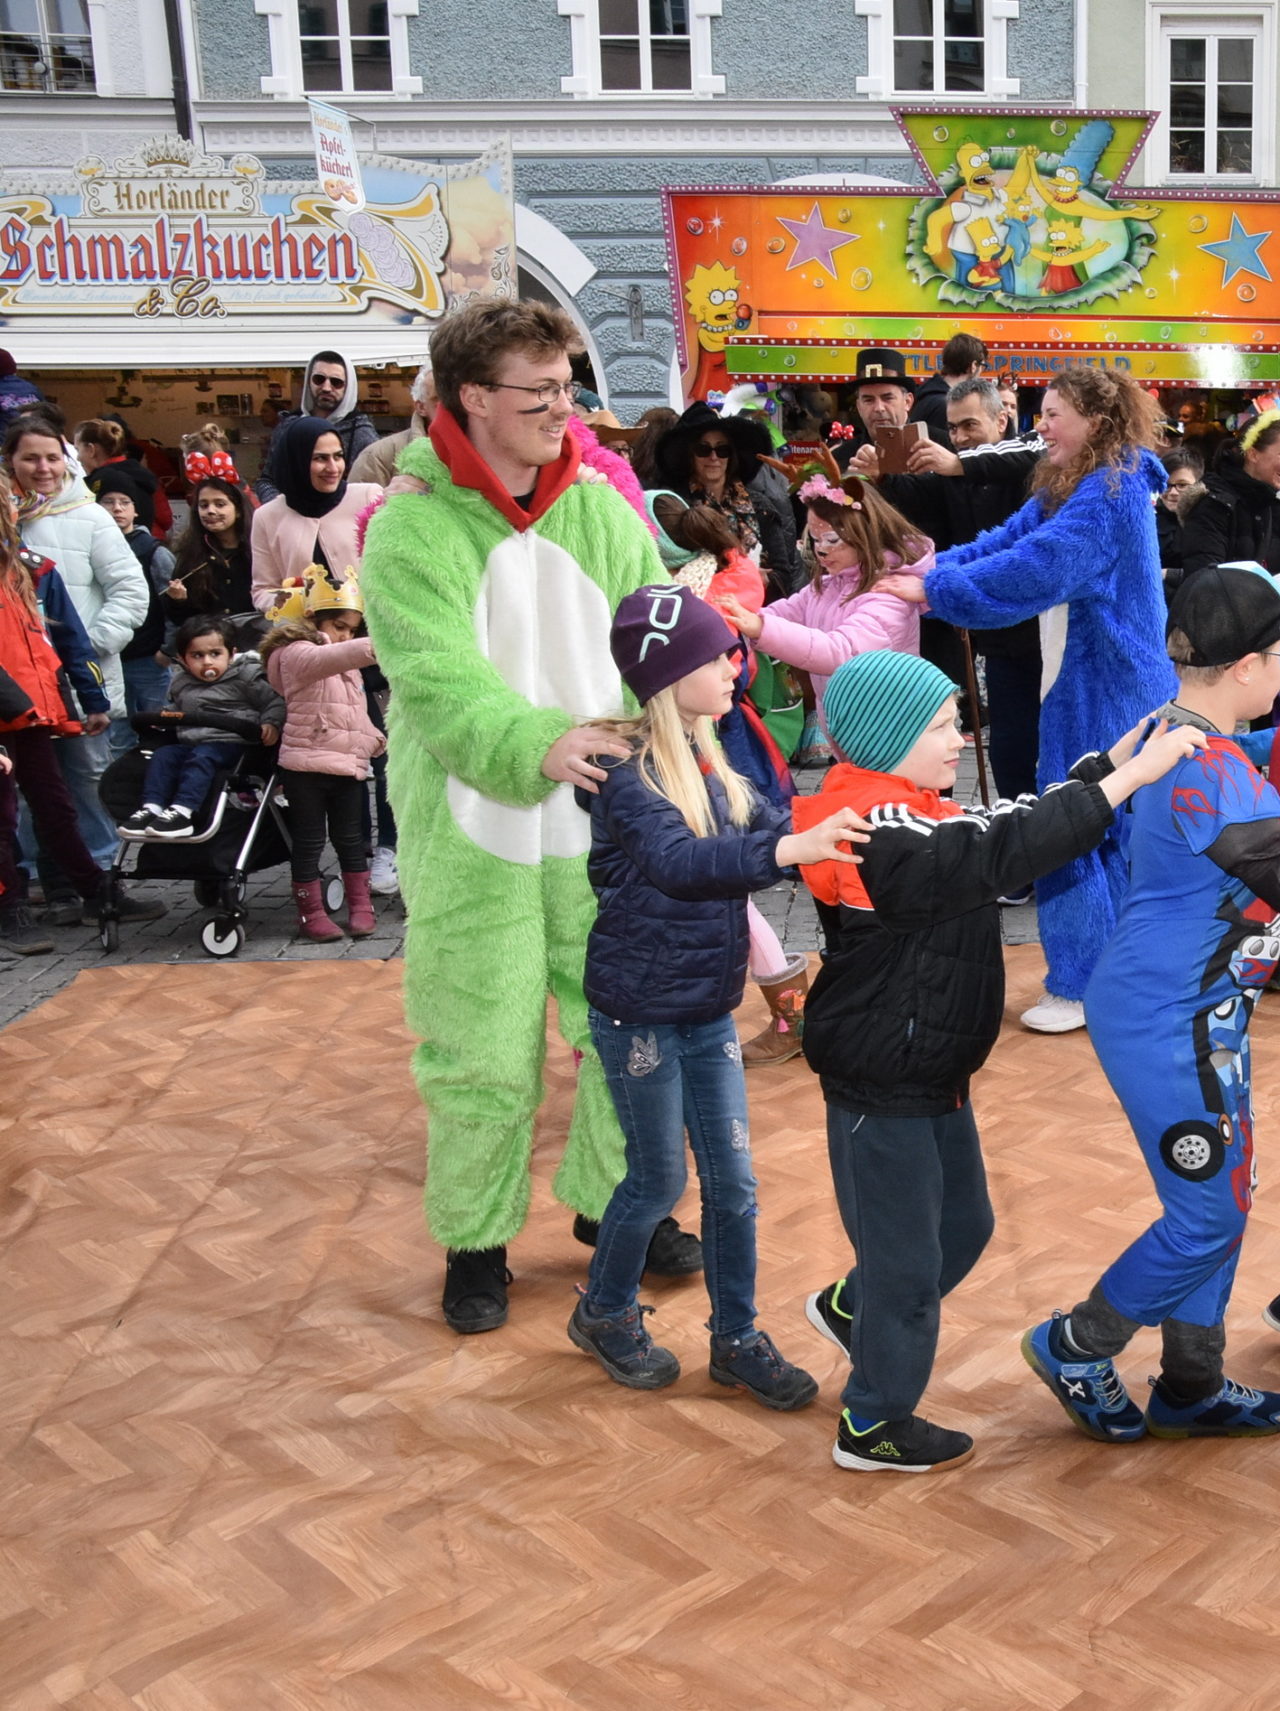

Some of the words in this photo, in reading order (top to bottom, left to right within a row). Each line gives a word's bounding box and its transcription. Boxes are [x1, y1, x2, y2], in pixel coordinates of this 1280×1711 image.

[113, 181, 231, 211] Horländer
[0, 216, 359, 281] Schmalzkuchen
[135, 287, 165, 317] &
[170, 276, 226, 317] Co.
